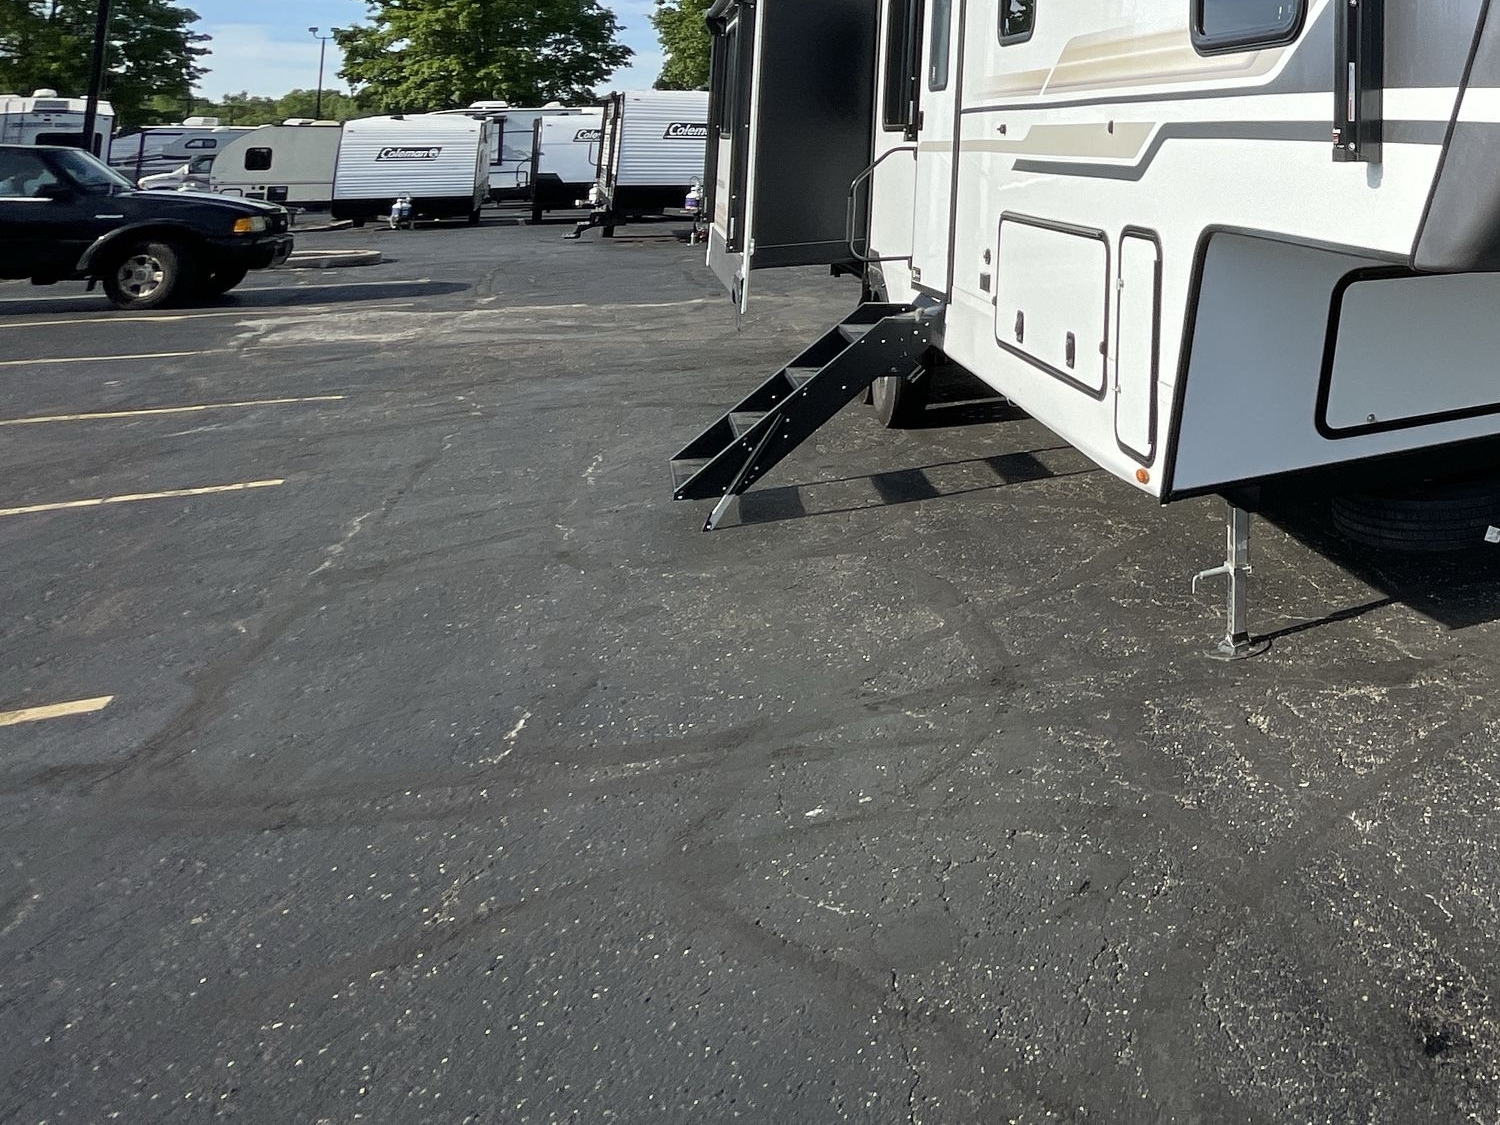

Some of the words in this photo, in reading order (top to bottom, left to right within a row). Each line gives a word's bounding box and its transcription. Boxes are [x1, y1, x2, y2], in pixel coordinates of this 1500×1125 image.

[577, 129, 602, 140] Cole
[668, 123, 707, 136] Colem
[380, 148, 429, 159] Coleman
